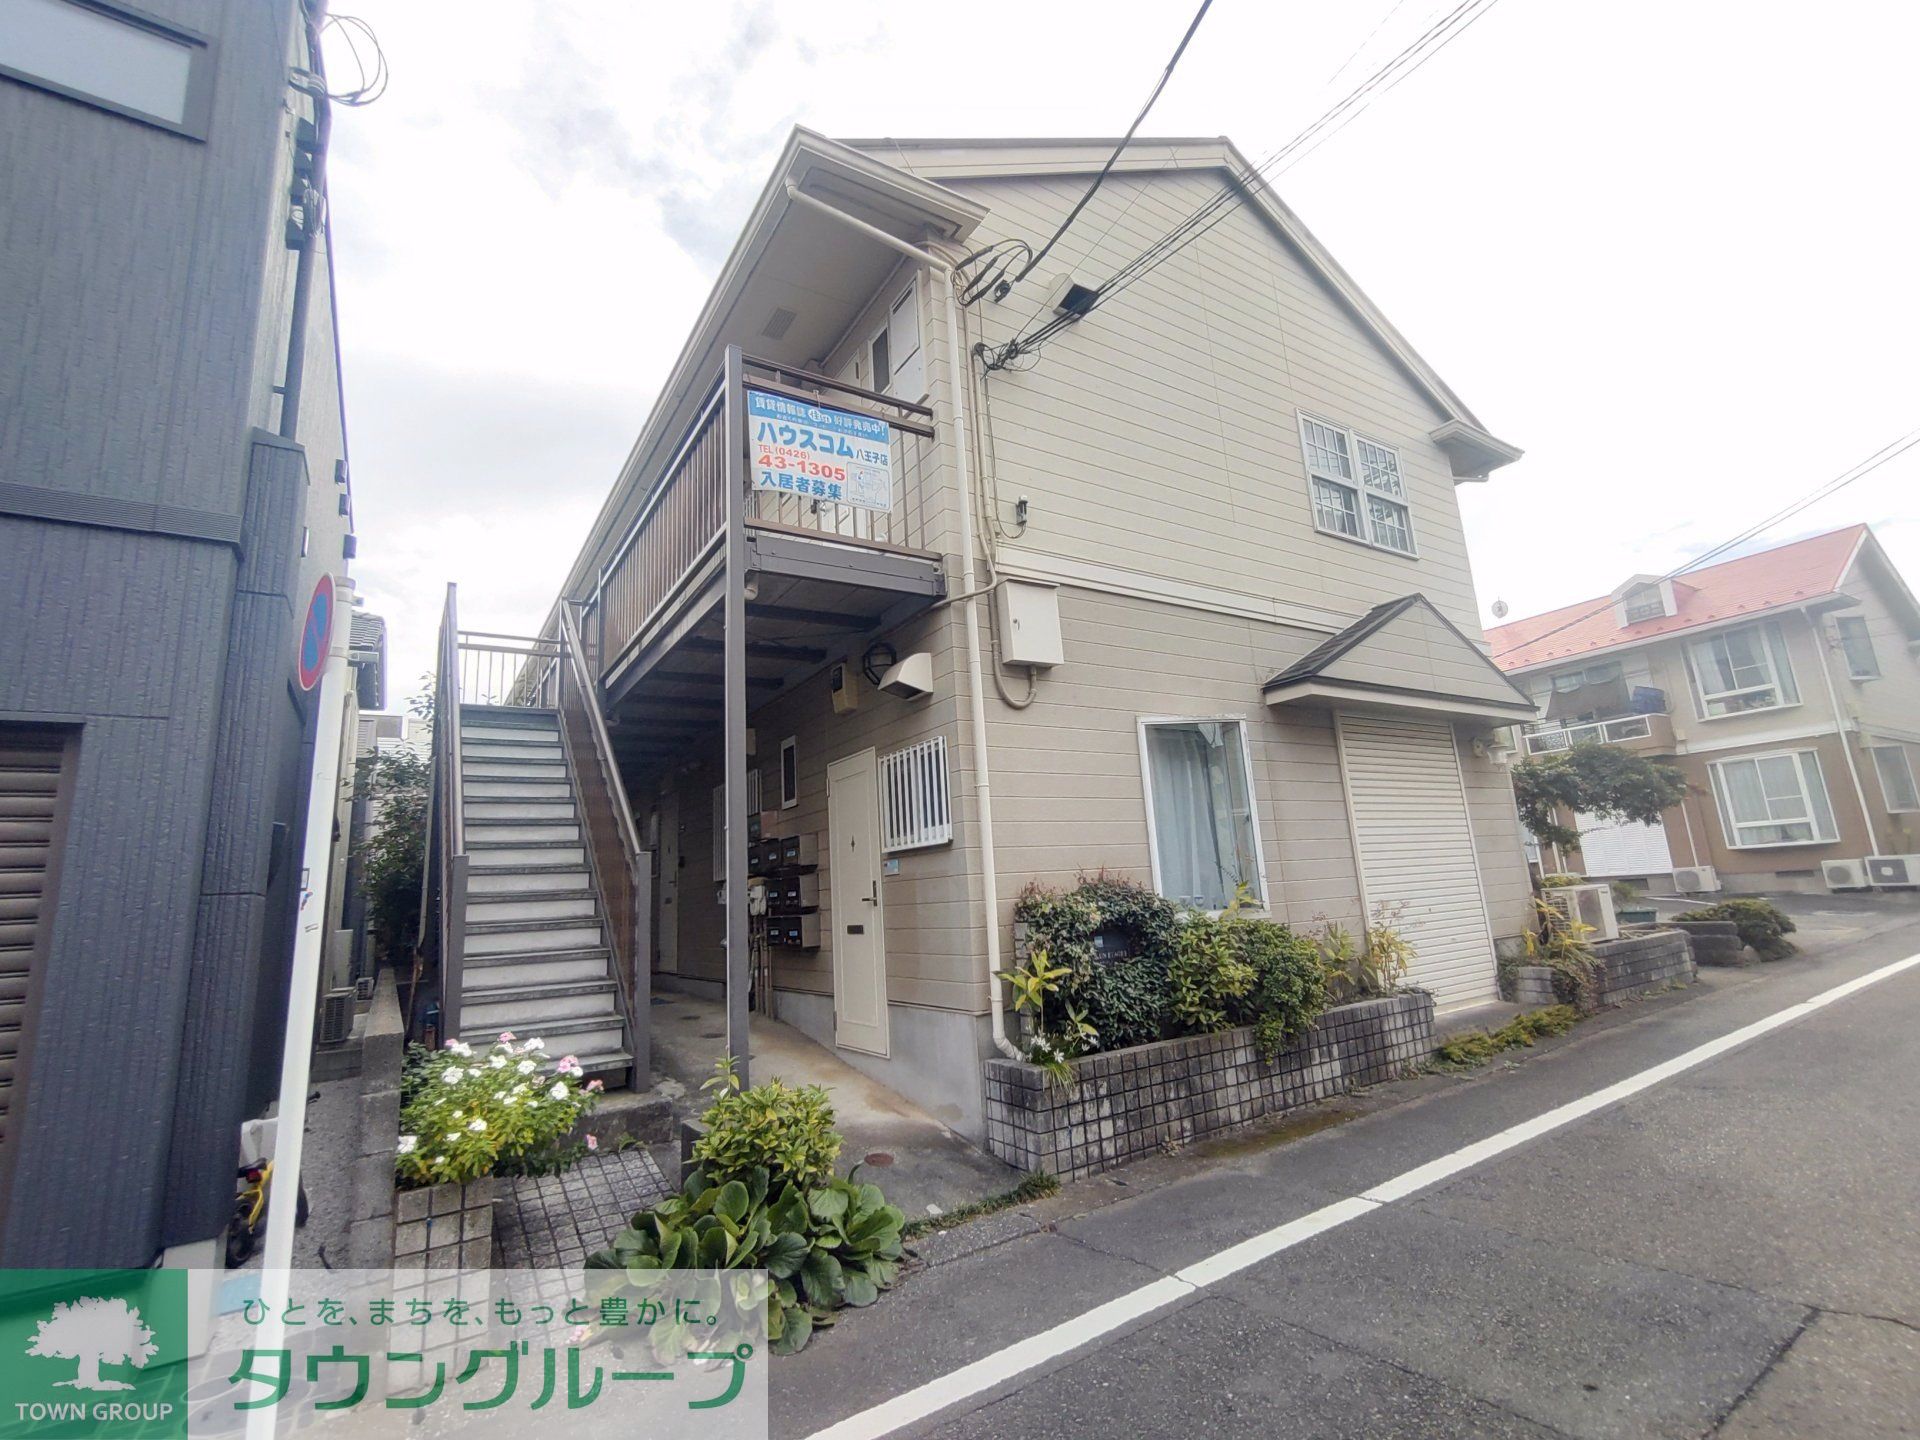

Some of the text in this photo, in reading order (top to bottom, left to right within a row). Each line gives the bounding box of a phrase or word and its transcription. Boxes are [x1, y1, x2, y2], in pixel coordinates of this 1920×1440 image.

[757, 422, 854, 459] ハウスコム
[856, 449, 889, 466] 八王子店
[758, 454, 845, 481] 43-1305
[761, 471, 842, 500] 入居者募集
